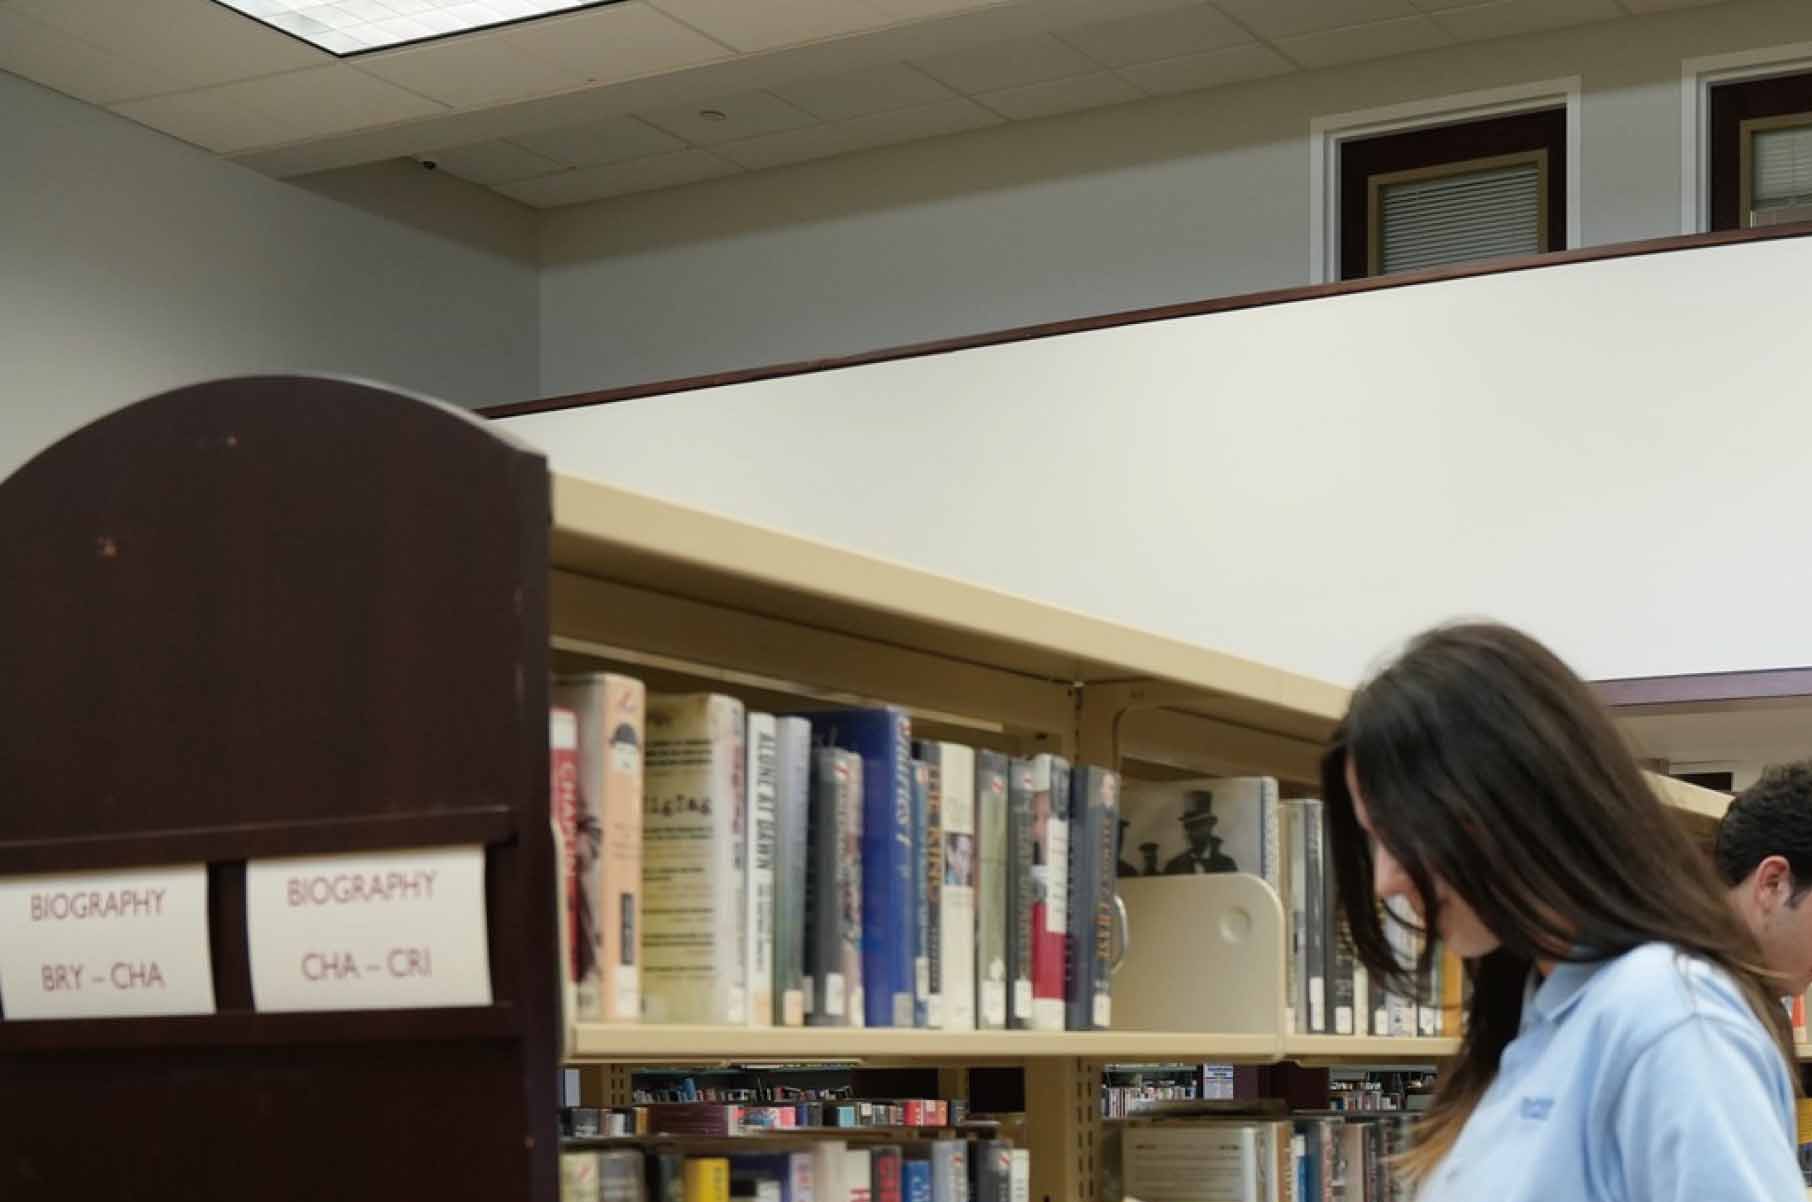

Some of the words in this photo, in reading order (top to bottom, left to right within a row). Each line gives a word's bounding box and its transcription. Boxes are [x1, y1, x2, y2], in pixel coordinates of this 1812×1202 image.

[756, 733, 777, 788] ALONE
[30, 888, 167, 921] BIOGRAPHY
[287, 870, 438, 907] BIOGRAPHY
[41, 963, 84, 991] BRY
[110, 960, 166, 991] CHA
[301, 950, 361, 982] CHA
[388, 947, 431, 979] CRI
